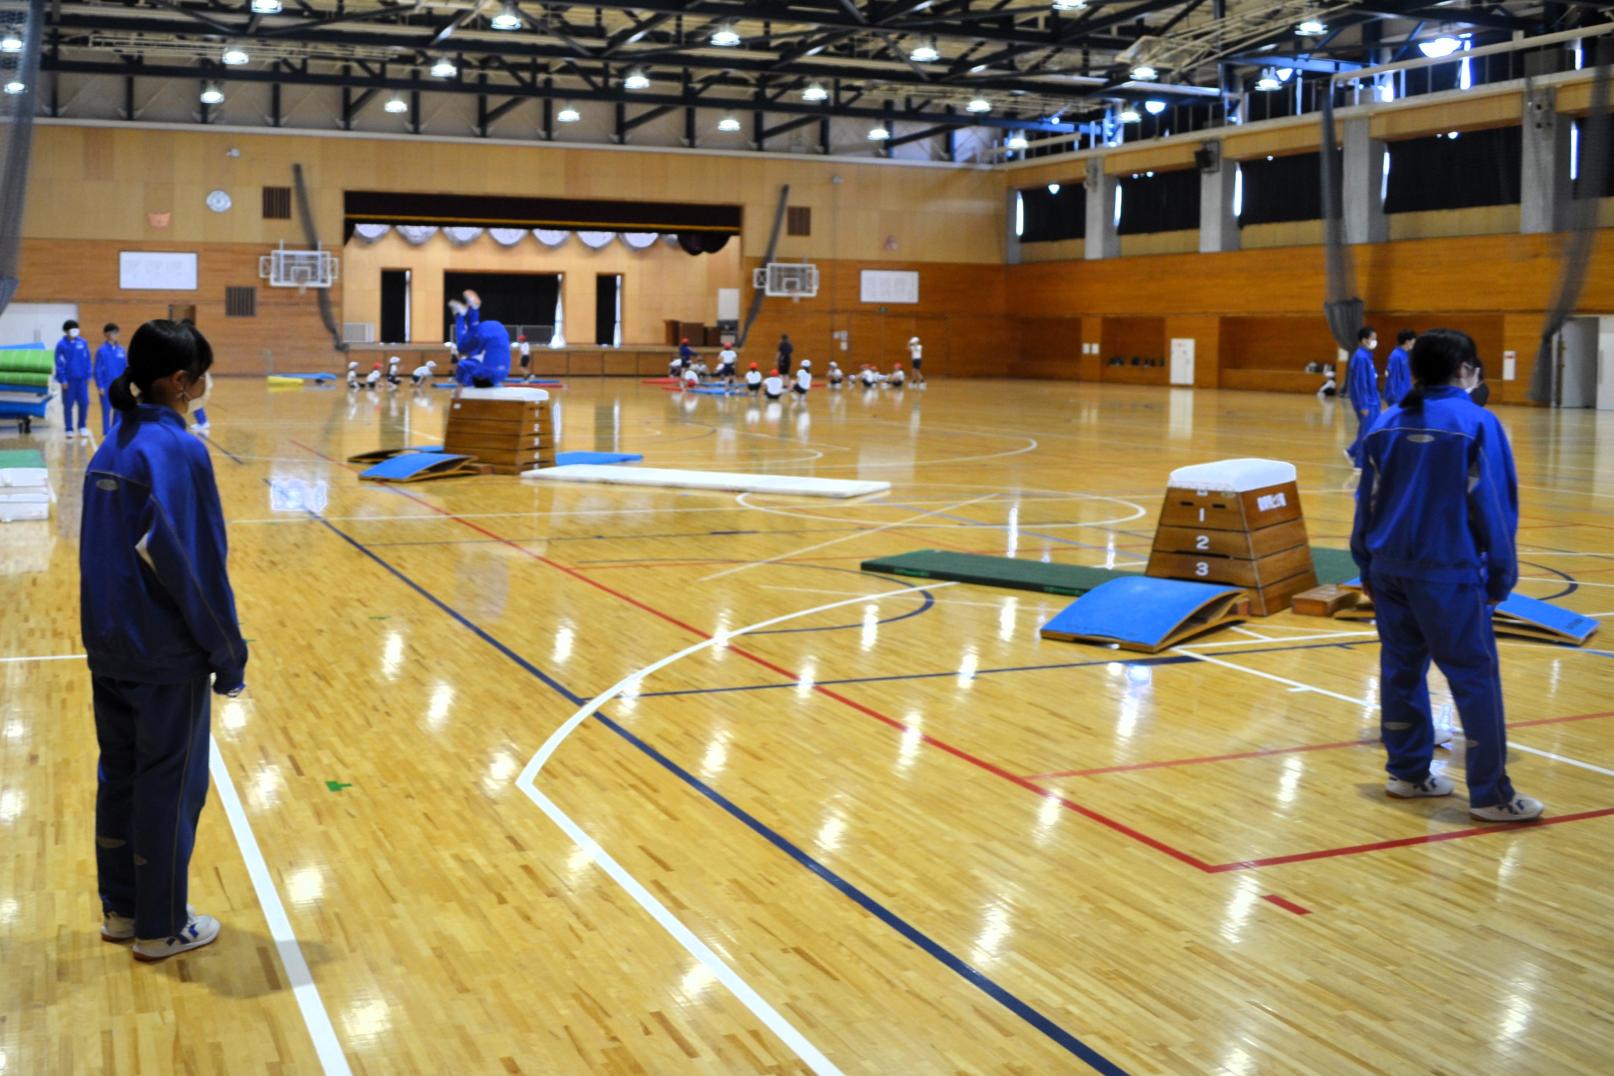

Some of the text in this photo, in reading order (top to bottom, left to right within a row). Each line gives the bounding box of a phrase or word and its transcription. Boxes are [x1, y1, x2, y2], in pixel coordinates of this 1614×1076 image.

[1199, 507, 1205, 522] 1
[1196, 535, 1209, 550] 2
[1195, 562, 1209, 576] 3
